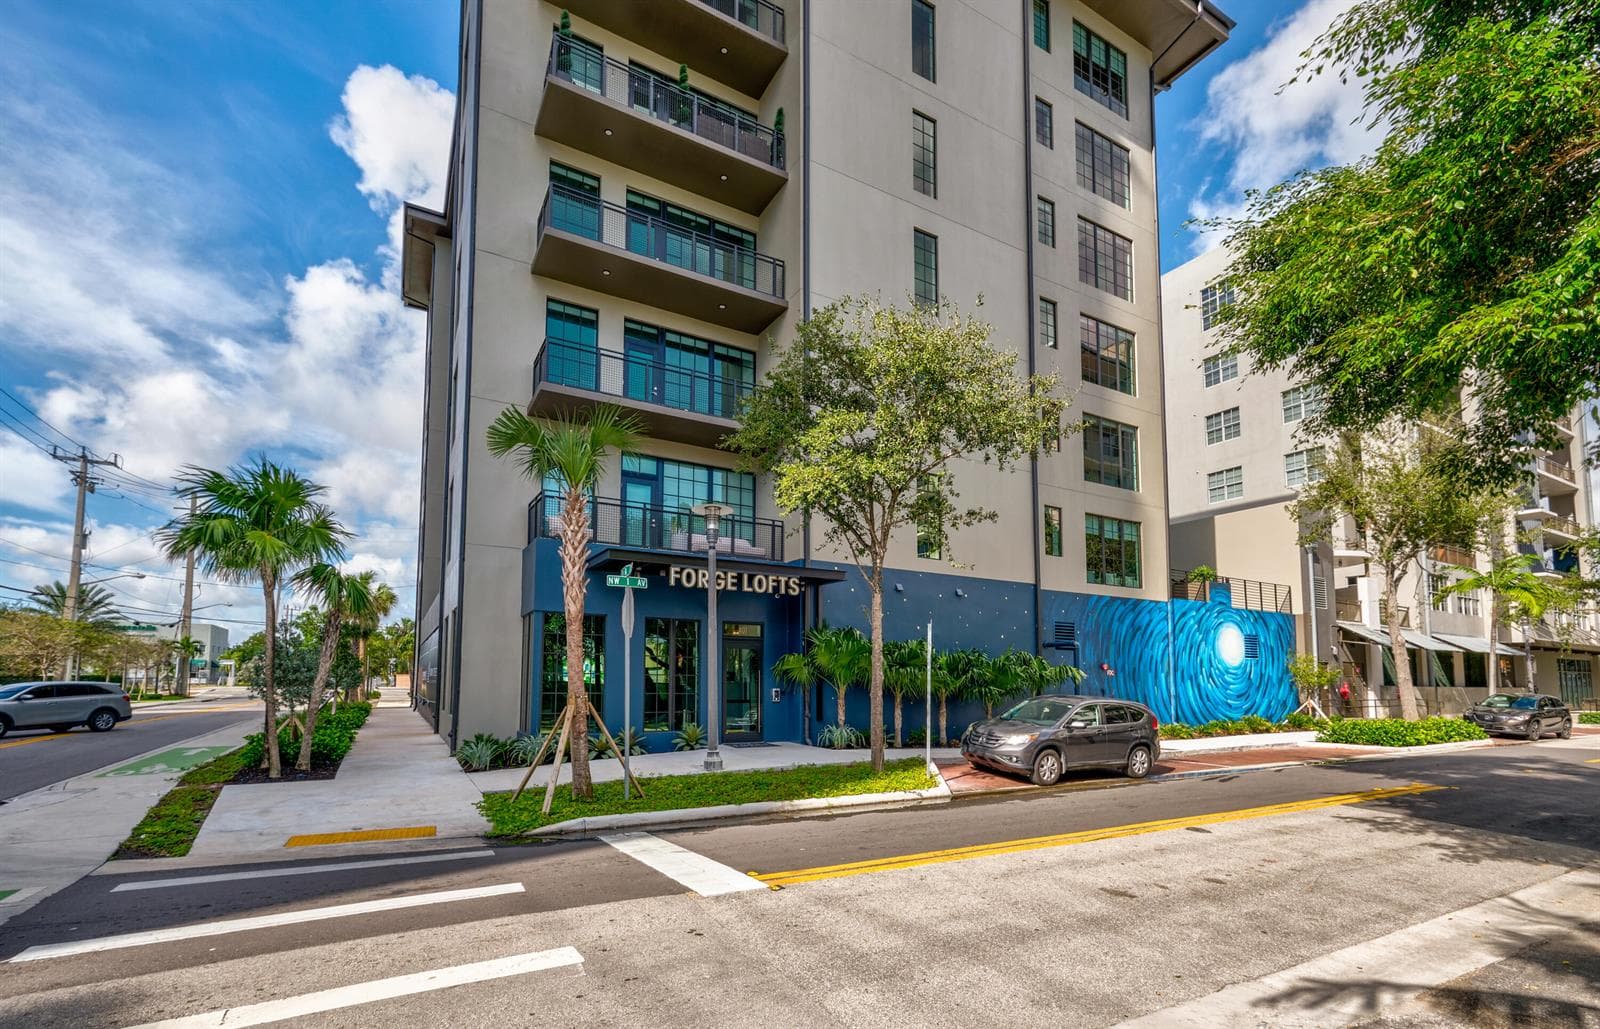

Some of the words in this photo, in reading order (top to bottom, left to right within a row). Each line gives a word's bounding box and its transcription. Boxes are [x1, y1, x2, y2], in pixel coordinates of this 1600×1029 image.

[608, 576, 620, 585] NW
[637, 578, 646, 587] AV
[669, 566, 738, 591] FORGE
[742, 573, 800, 596] LOFTS
